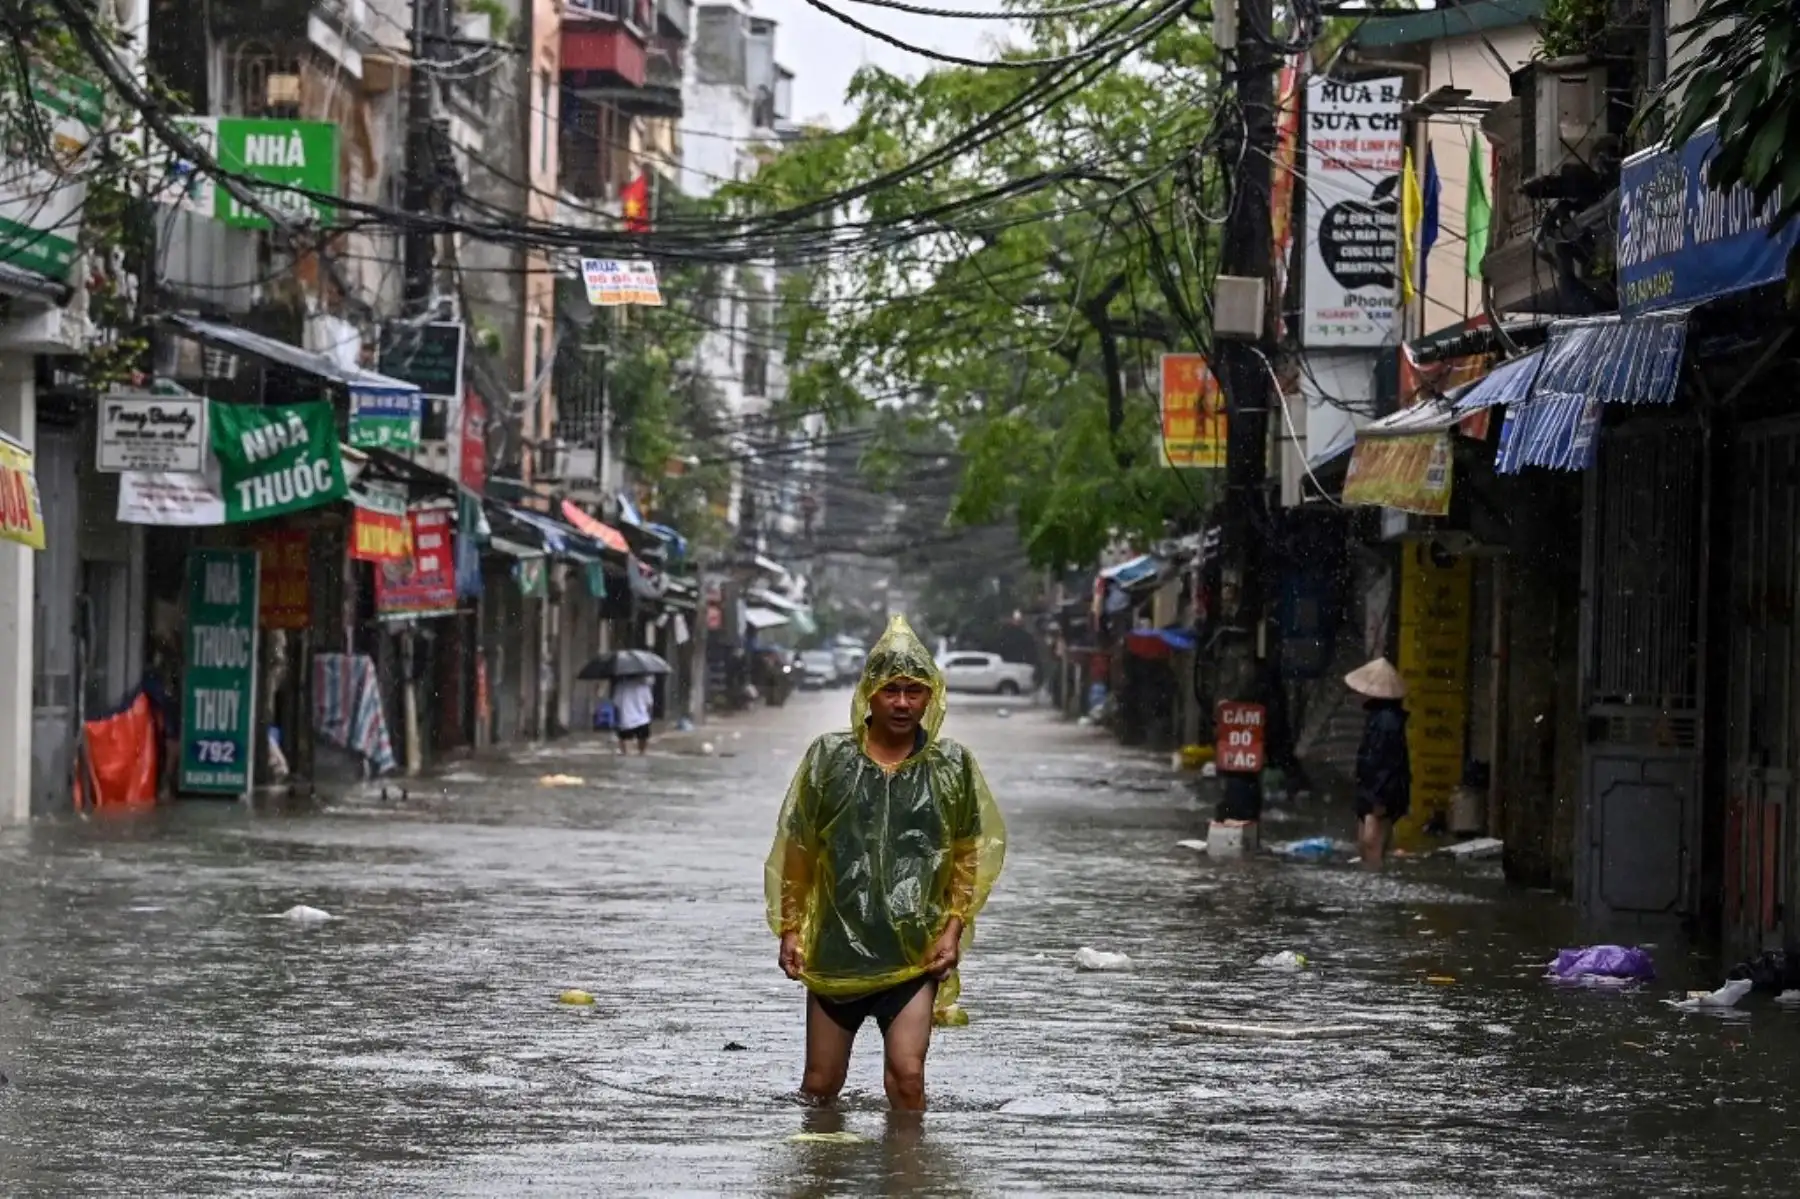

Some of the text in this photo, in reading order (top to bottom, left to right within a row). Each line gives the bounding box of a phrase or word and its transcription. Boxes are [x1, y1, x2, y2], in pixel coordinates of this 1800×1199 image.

[1321, 83, 1371, 103] MUA
[245, 129, 305, 167] NHÀ
[241, 410, 309, 463] NHÀ
[235, 450, 333, 512] THUỐC
[197, 740, 235, 763] 792
